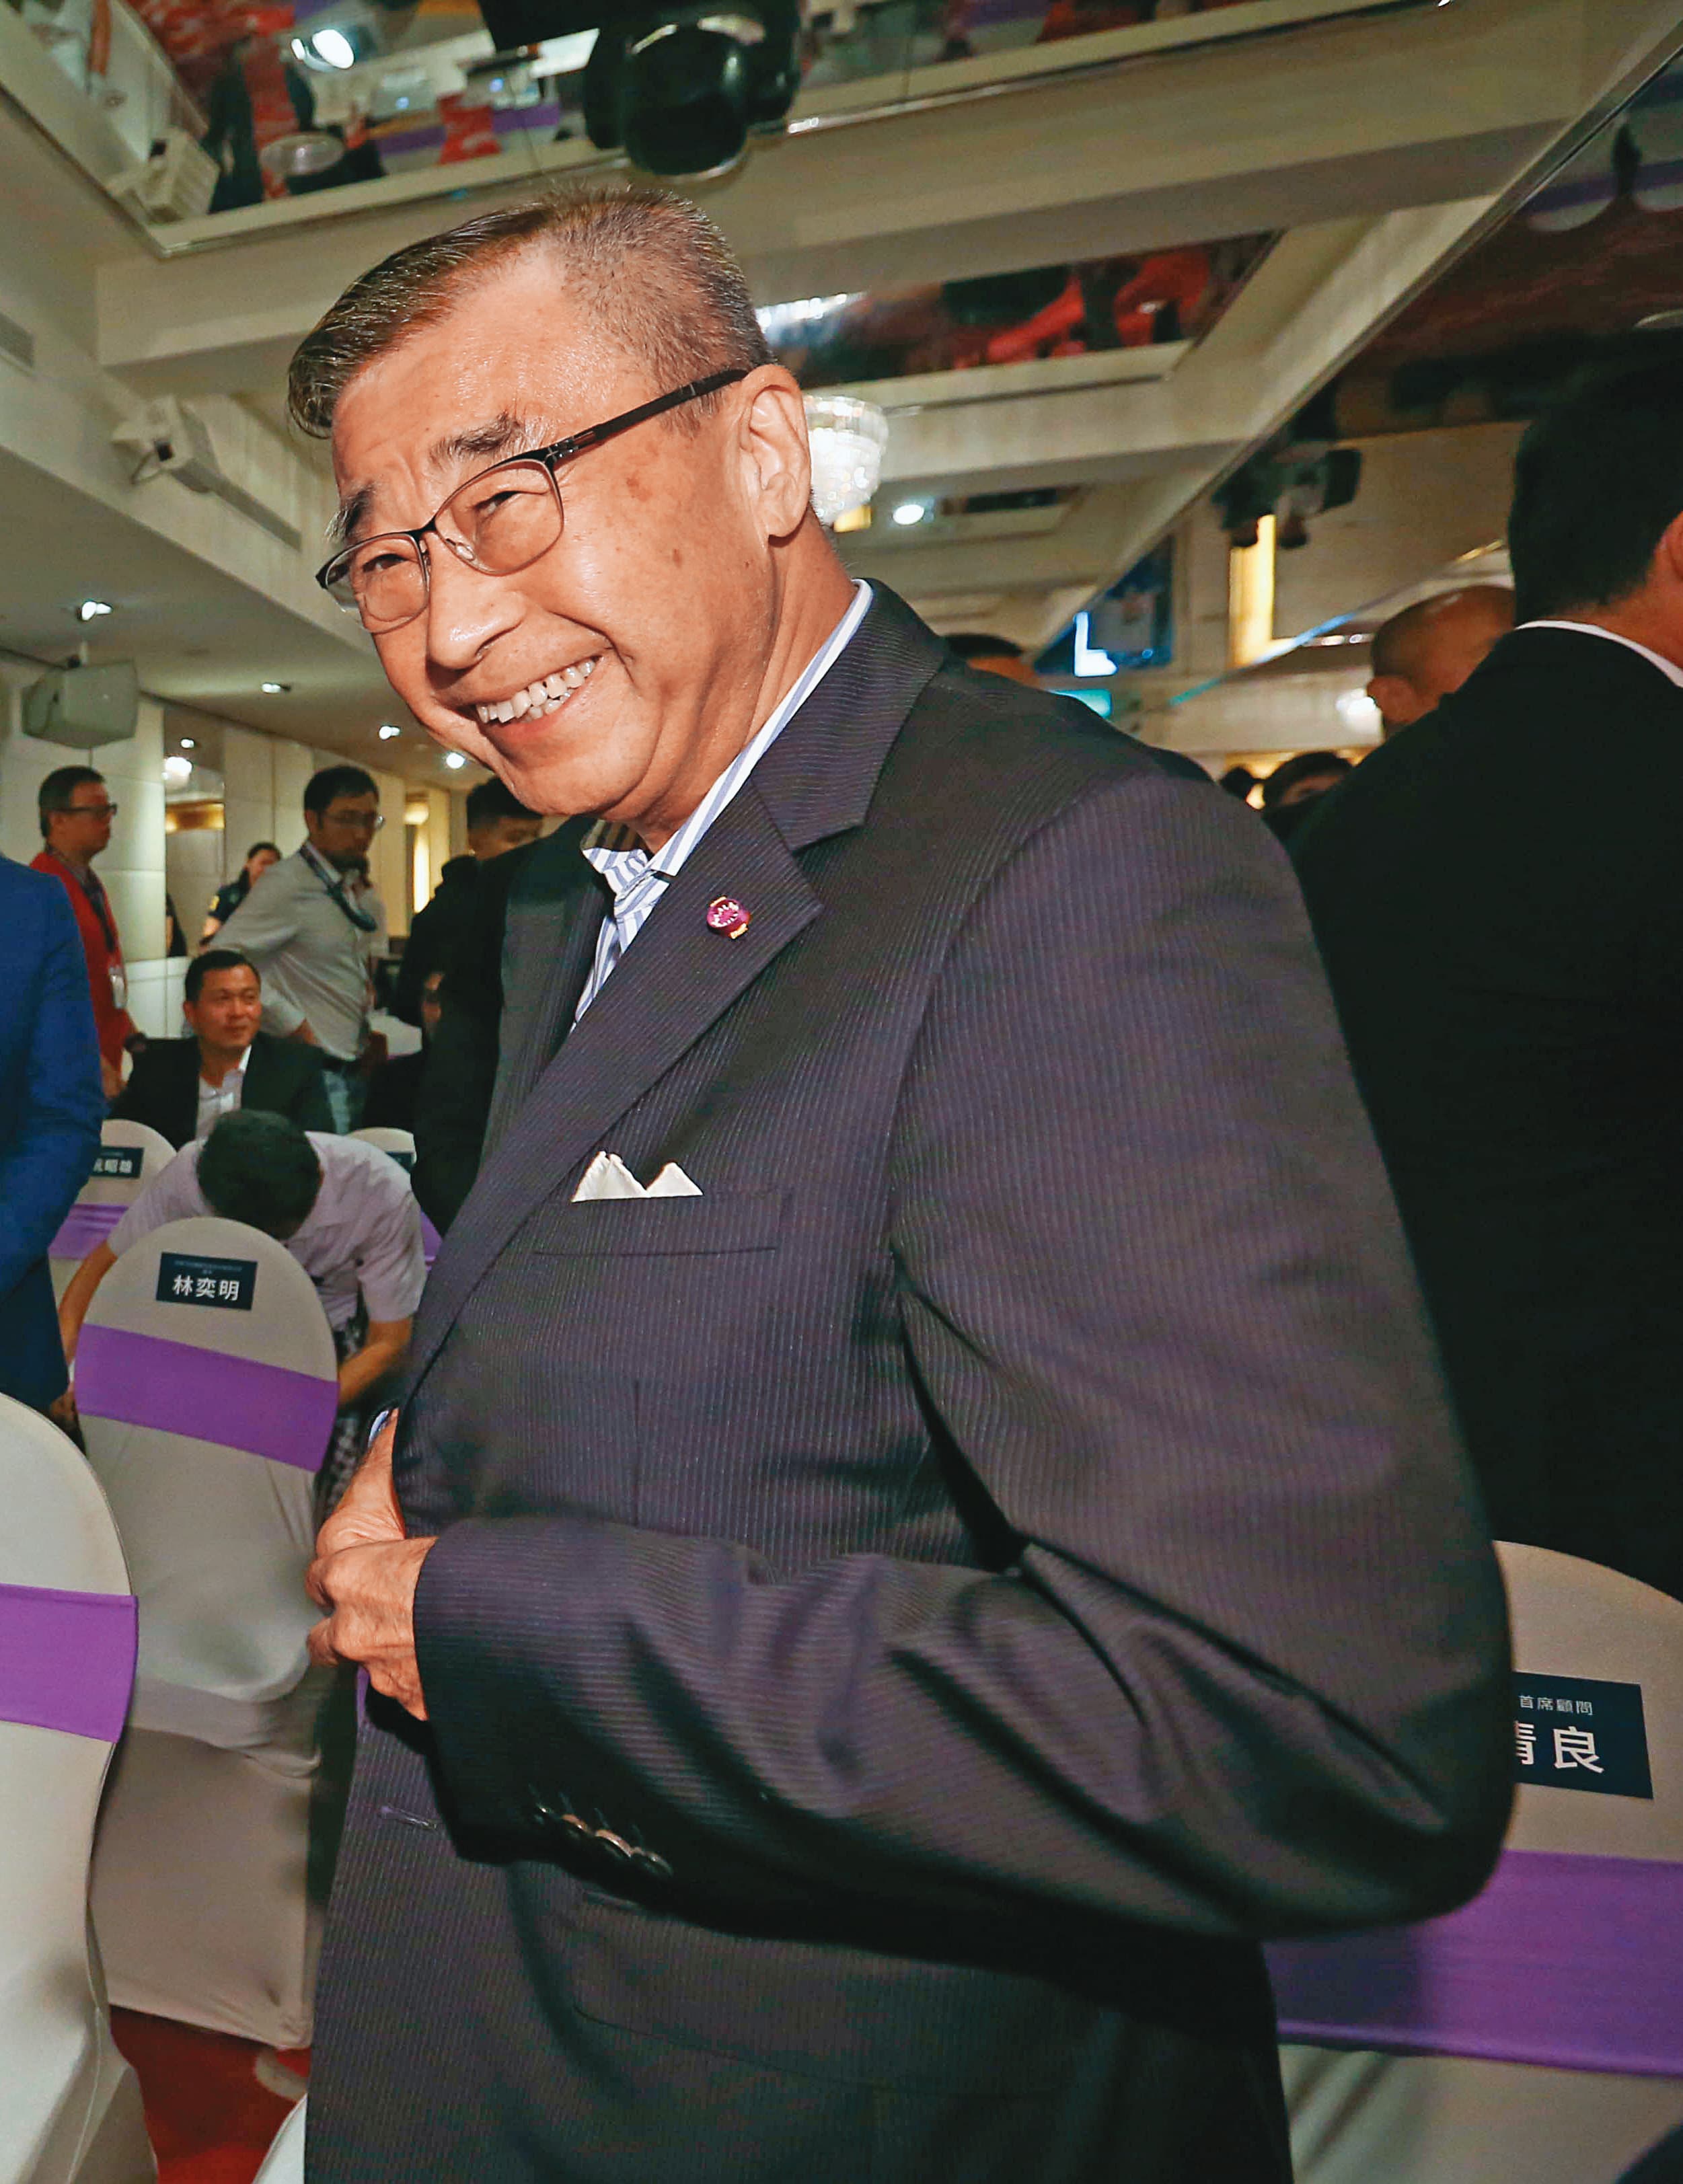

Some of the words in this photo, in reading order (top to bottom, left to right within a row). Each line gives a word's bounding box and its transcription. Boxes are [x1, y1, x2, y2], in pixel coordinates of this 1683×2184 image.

[172, 1275, 240, 1301] 林奕明
[1518, 1694, 1594, 1716] 首席顧問
